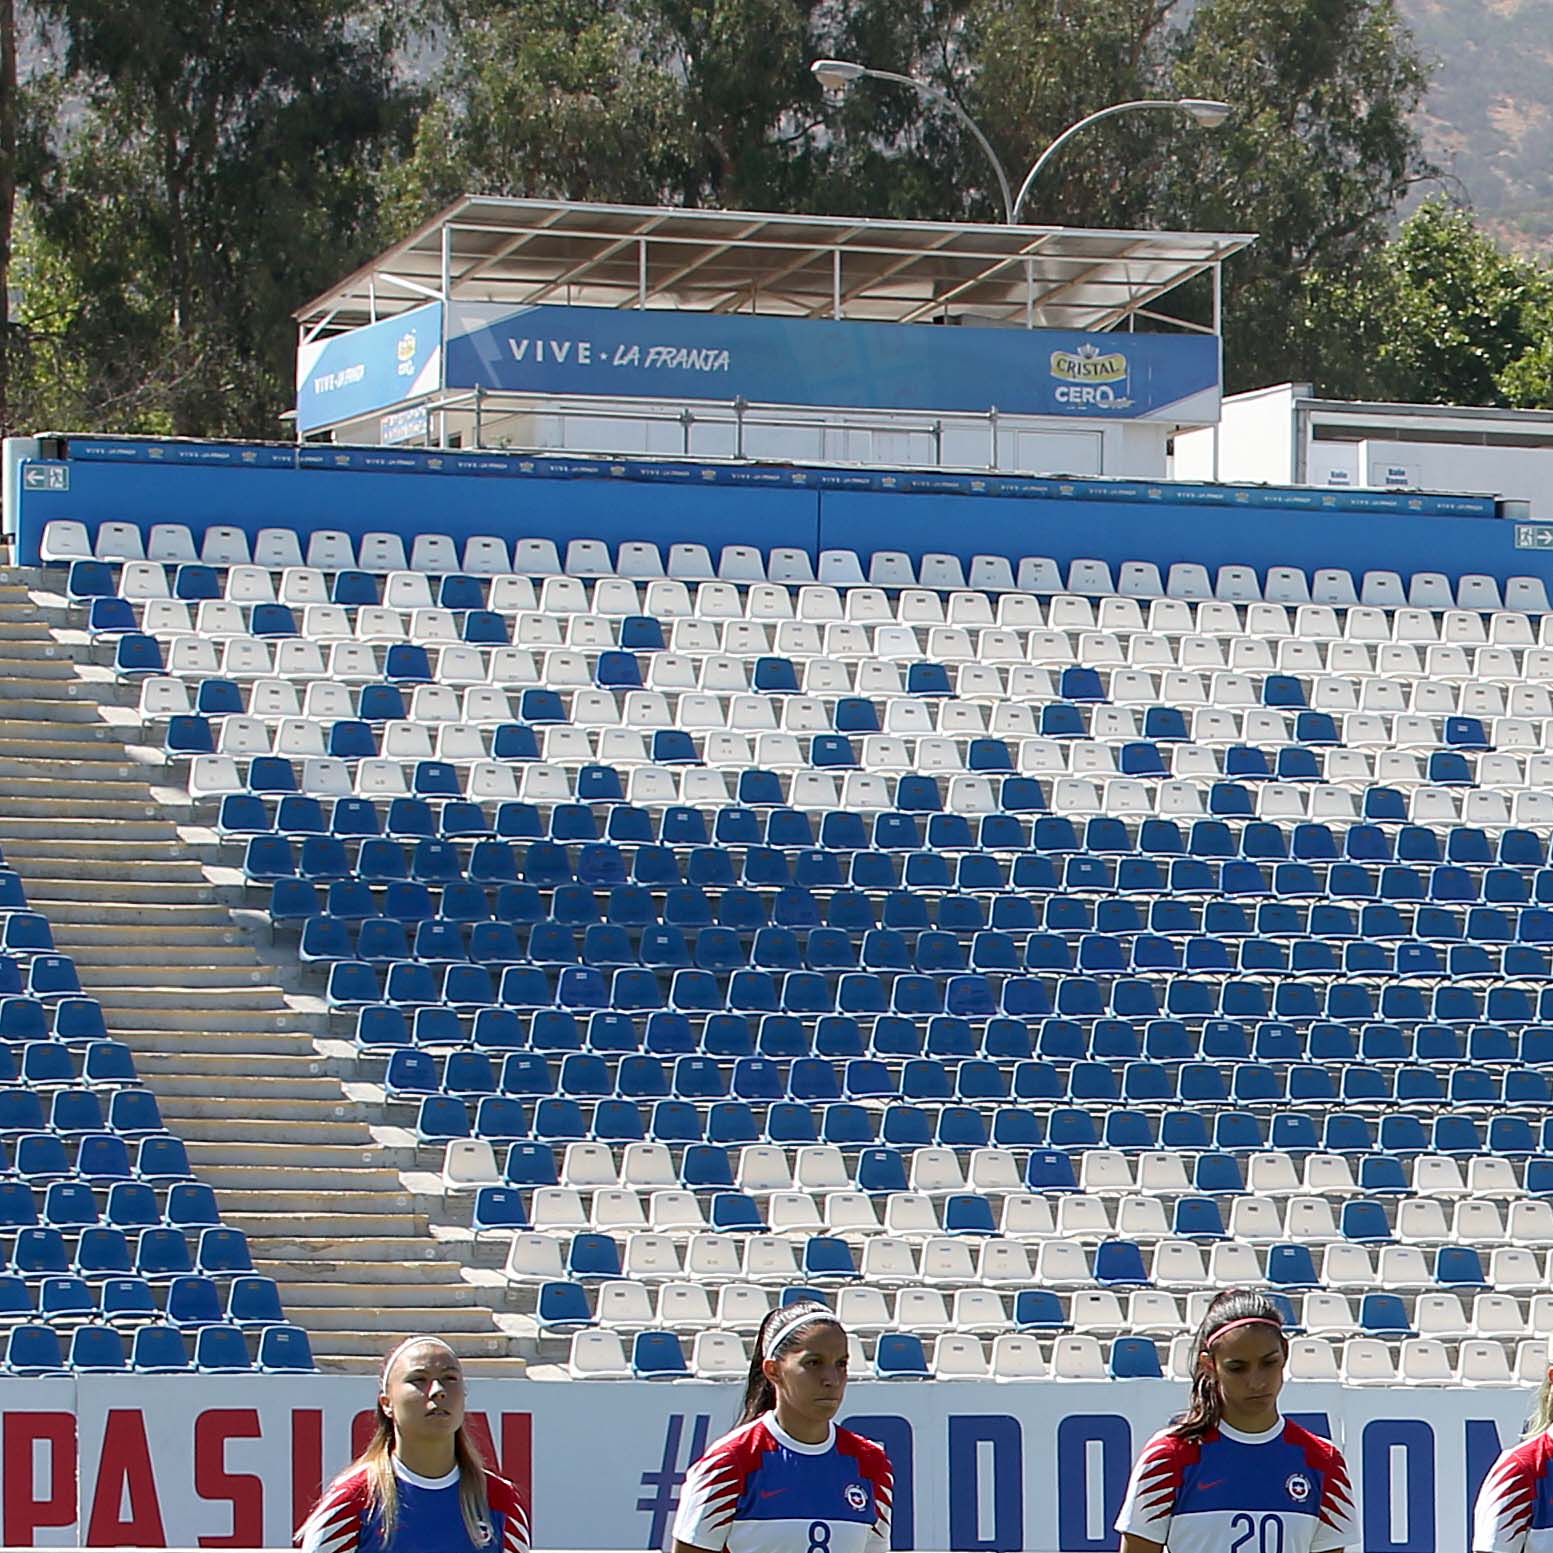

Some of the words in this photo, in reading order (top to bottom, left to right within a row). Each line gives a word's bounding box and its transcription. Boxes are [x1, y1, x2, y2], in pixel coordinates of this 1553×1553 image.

[508, 338, 591, 365] VIVE
[613, 343, 640, 367] LA
[644, 345, 731, 372] FRANJA
[1056, 358, 1121, 378] CRISTAL
[1055, 385, 1115, 409] CERO
